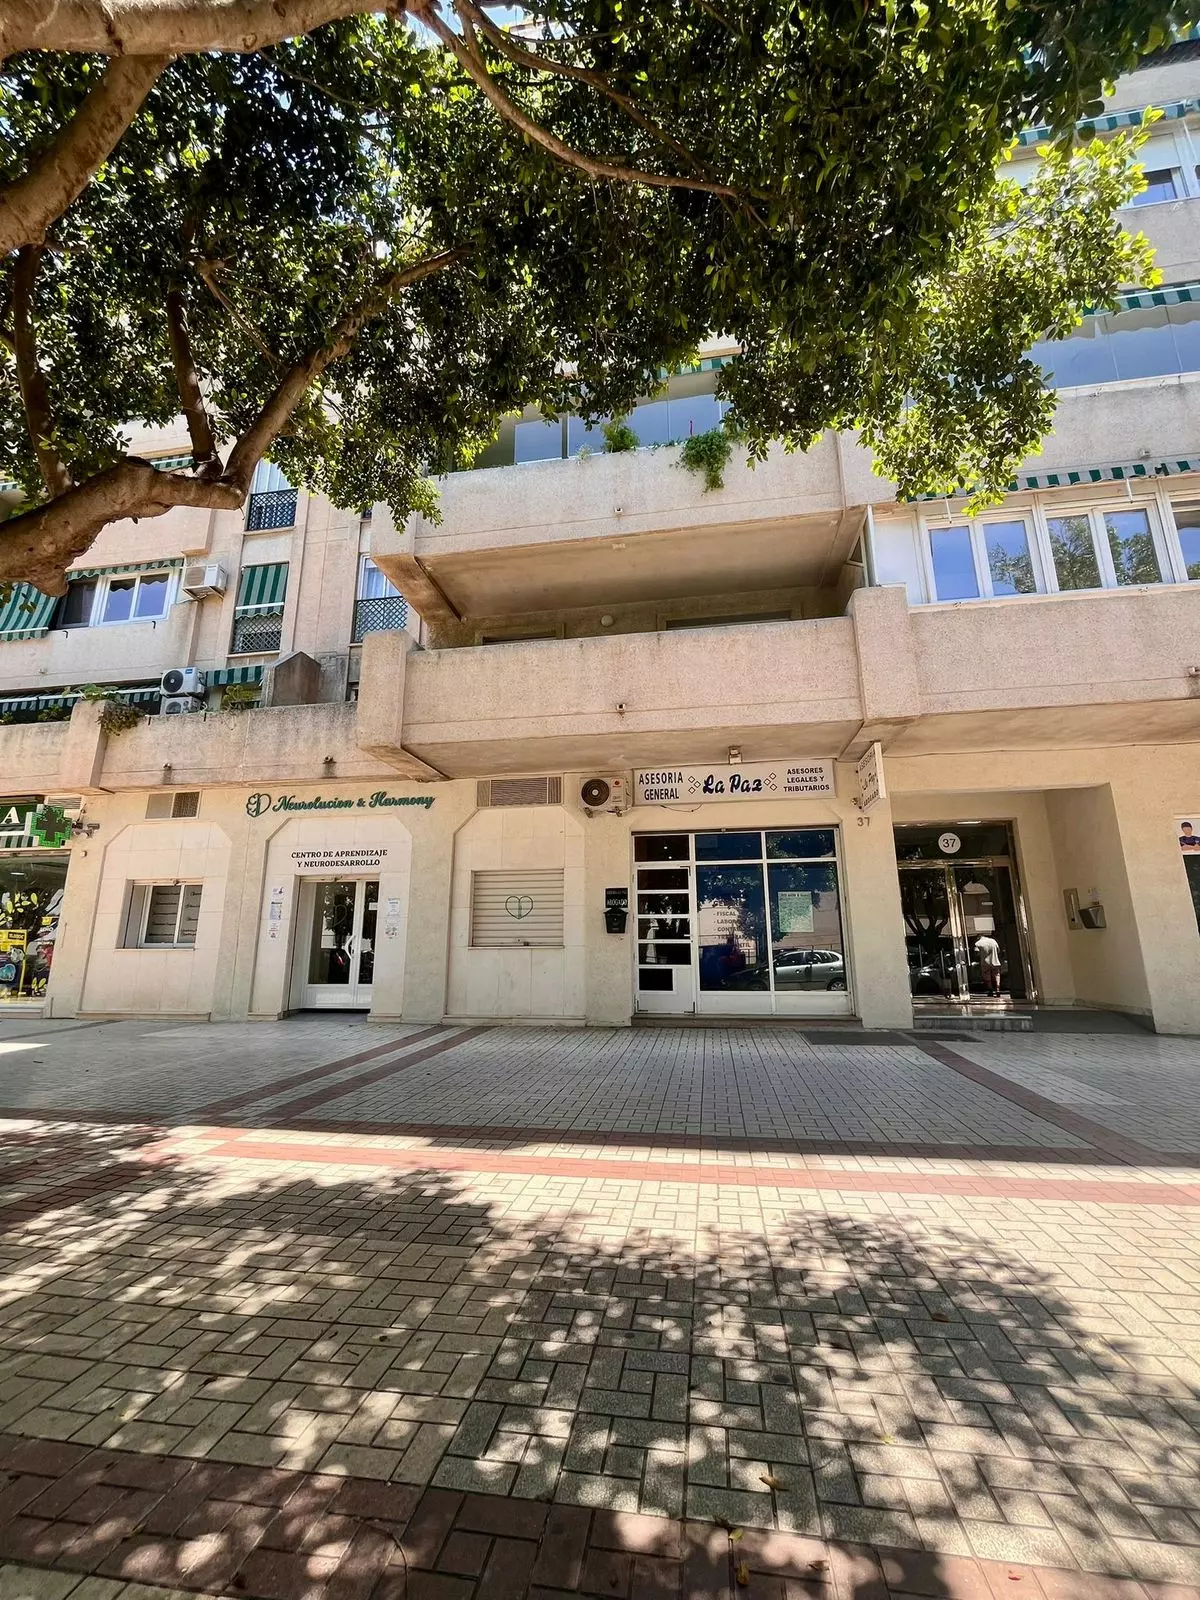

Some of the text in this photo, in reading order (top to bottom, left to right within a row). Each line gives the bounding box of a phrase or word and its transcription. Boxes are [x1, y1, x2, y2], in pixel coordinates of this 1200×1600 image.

[787, 767, 824, 775] ASESORES
[639, 771, 684, 785] ASESORIA
[703, 774, 763, 794] La Paz
[783, 784, 830, 792] TRIBUTARIOS
[644, 787, 680, 800] GENERAL
[356, 798, 366, 807] &
[368, 791, 436, 810] Harmony
[857, 817, 871, 827] 37
[942, 839, 956, 848] 37
[291, 851, 322, 859] CENTRO
[335, 849, 388, 858] APRENDIZAJE
[303, 859, 381, 868] NEURODESARROLLO
